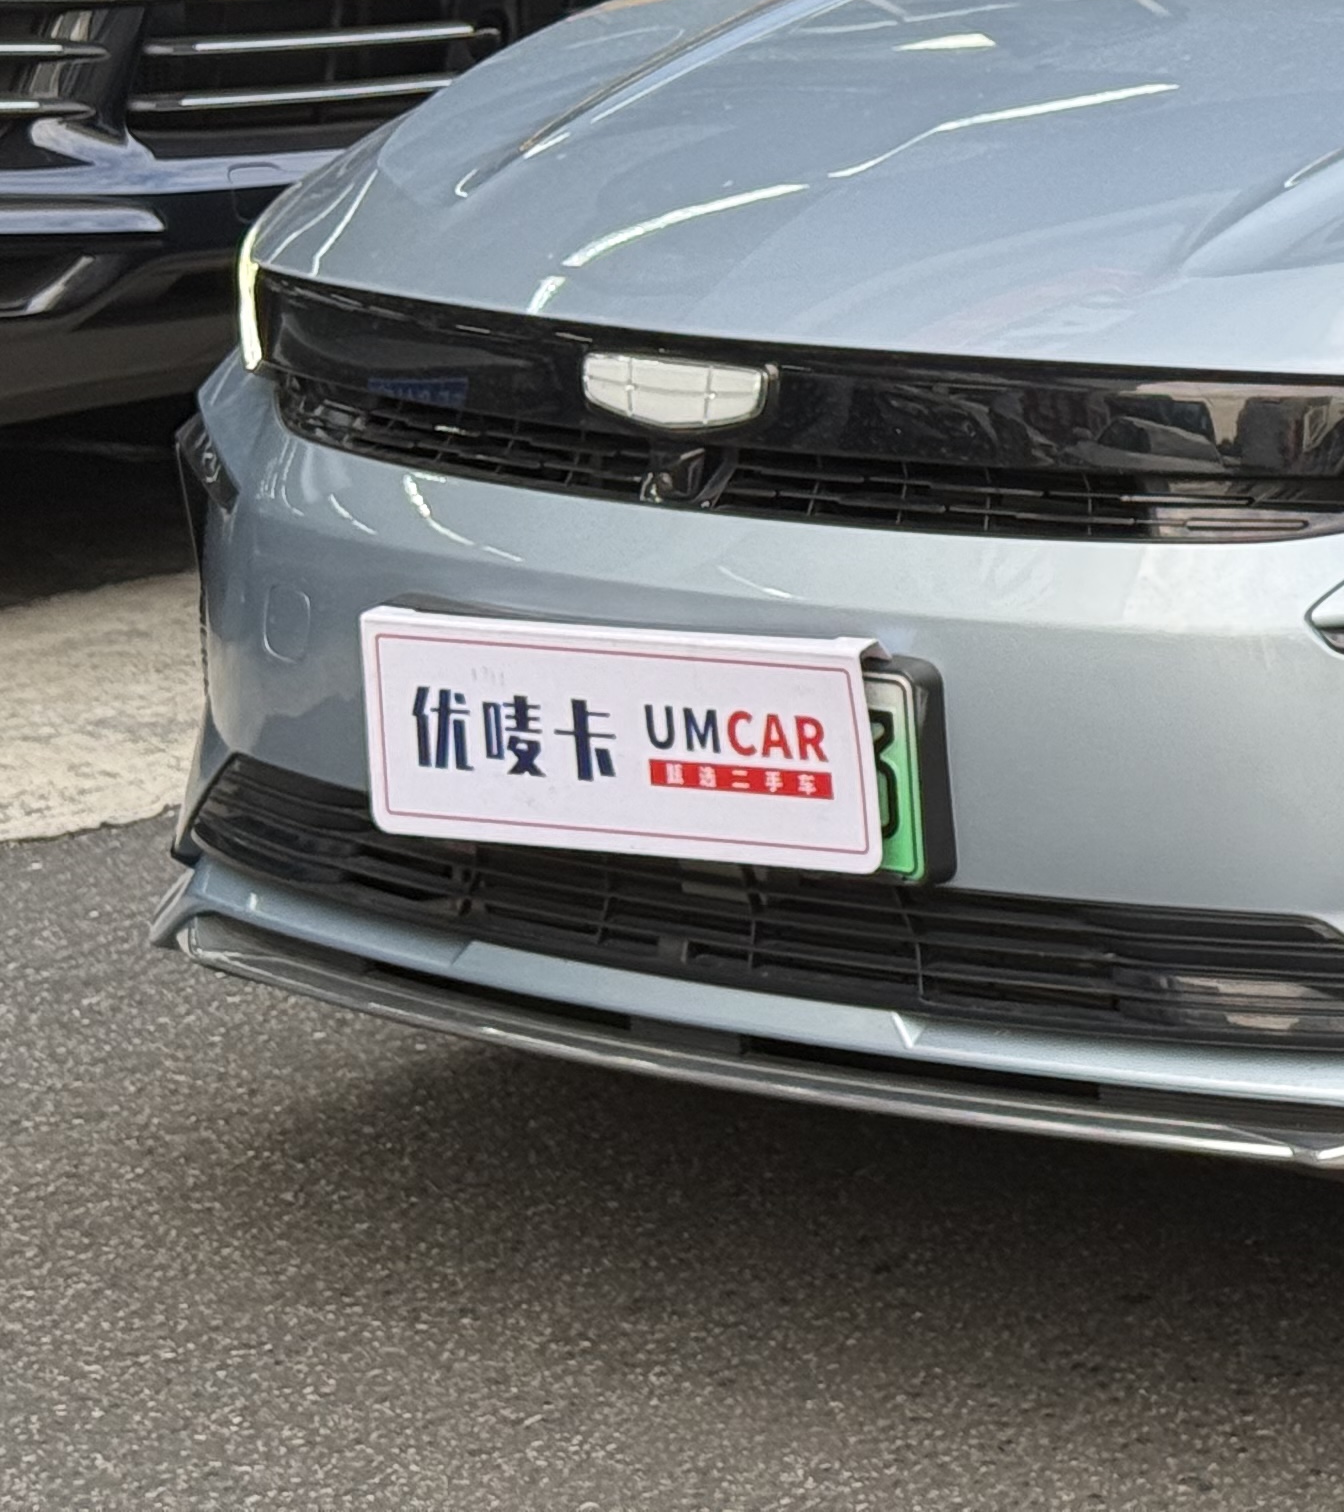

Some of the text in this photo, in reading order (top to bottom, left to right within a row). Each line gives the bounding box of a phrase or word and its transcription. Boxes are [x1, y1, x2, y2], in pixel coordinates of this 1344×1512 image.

[412, 685, 617, 782] 优唛卡
[643, 703, 829, 763] UMCAR
